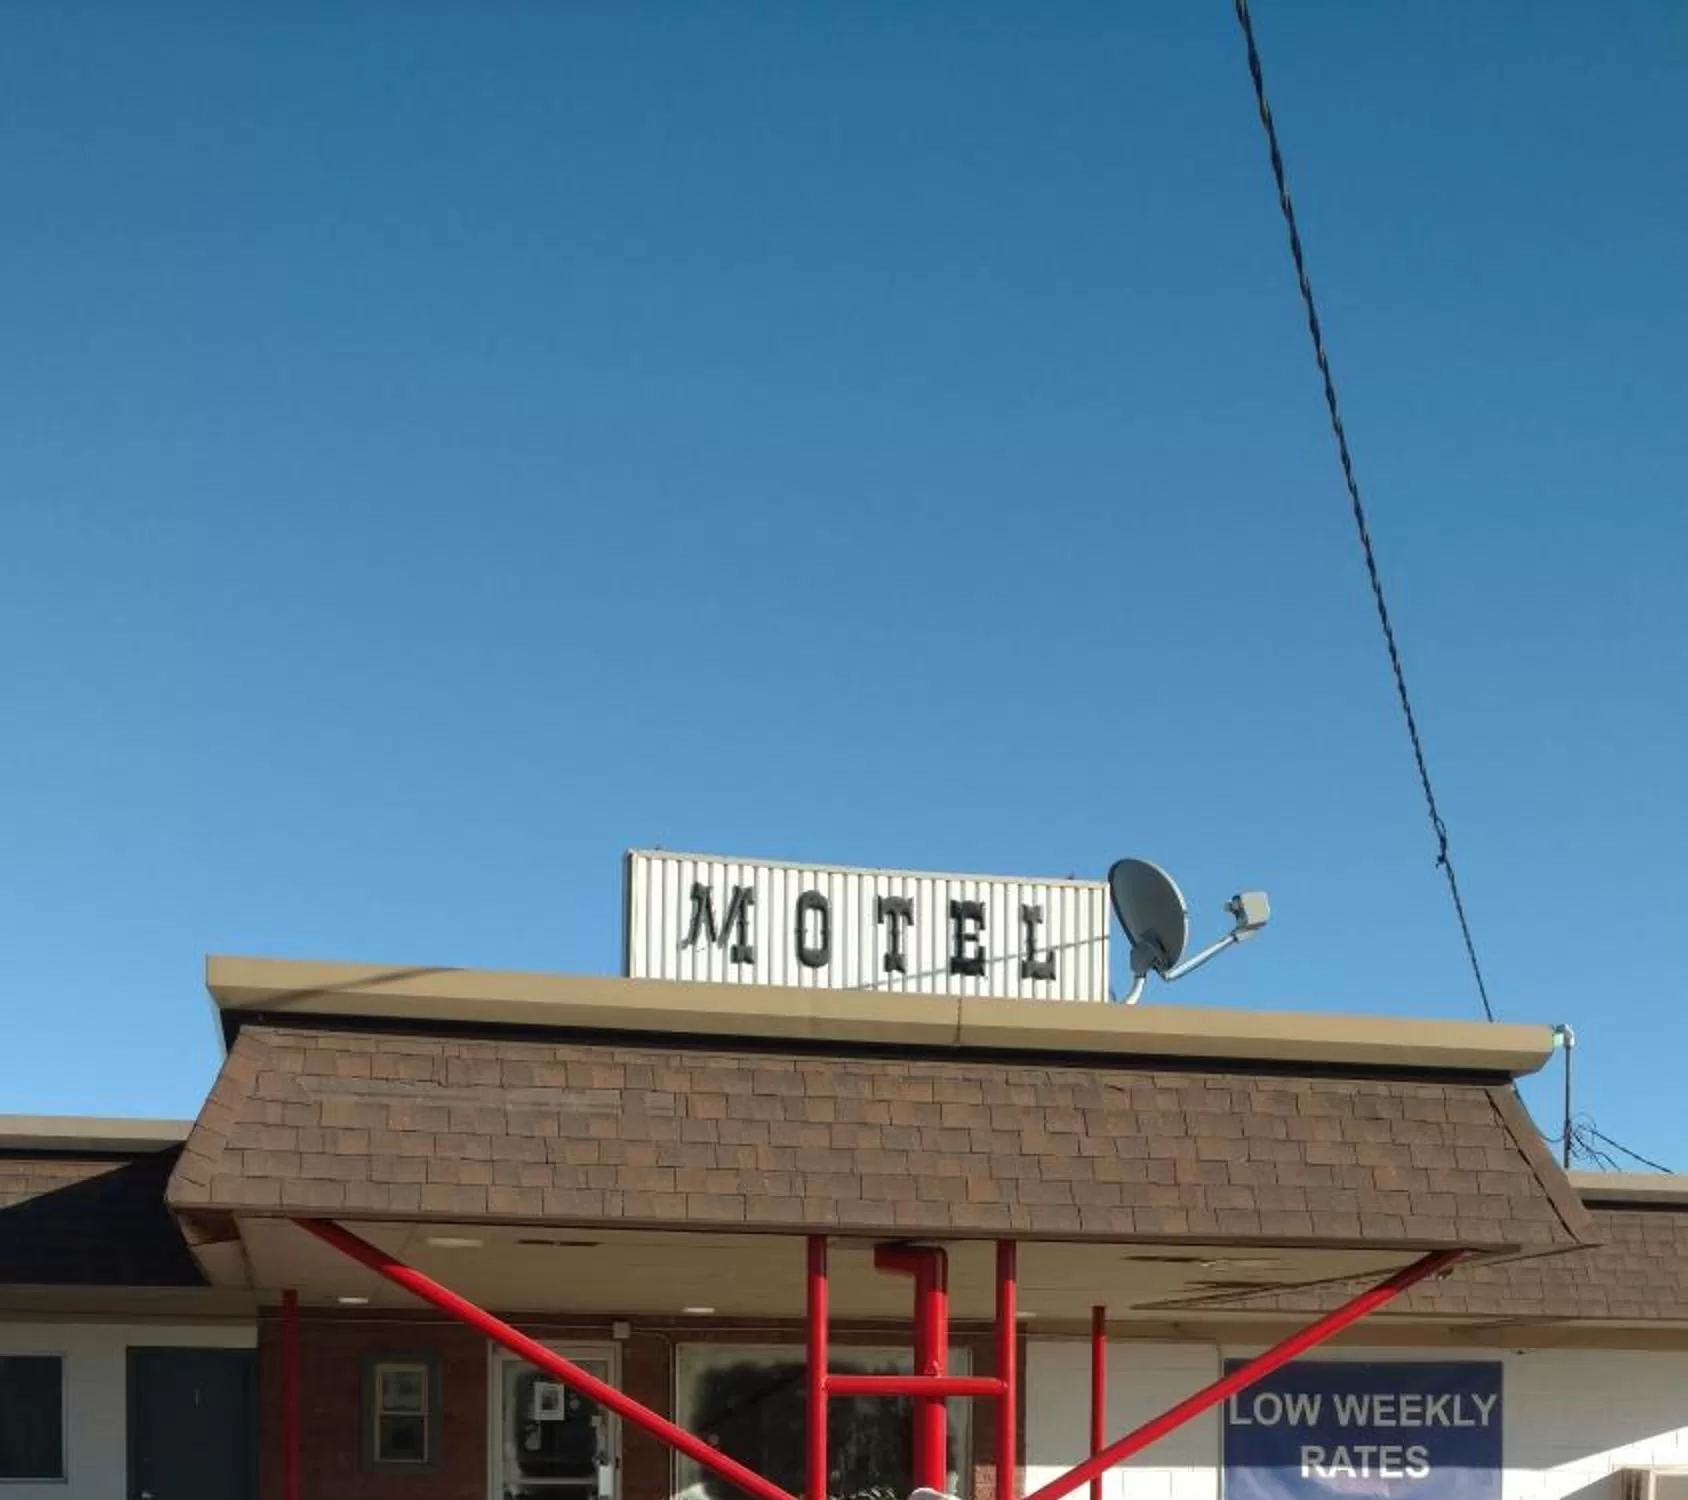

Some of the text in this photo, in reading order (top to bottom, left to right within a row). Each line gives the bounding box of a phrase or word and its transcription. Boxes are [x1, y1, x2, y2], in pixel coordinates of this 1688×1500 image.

[680, 881, 1057, 981] MOTEL
[1229, 1391, 1498, 1427] LOW WEEKLY
[1301, 1445, 1431, 1479] RATES
